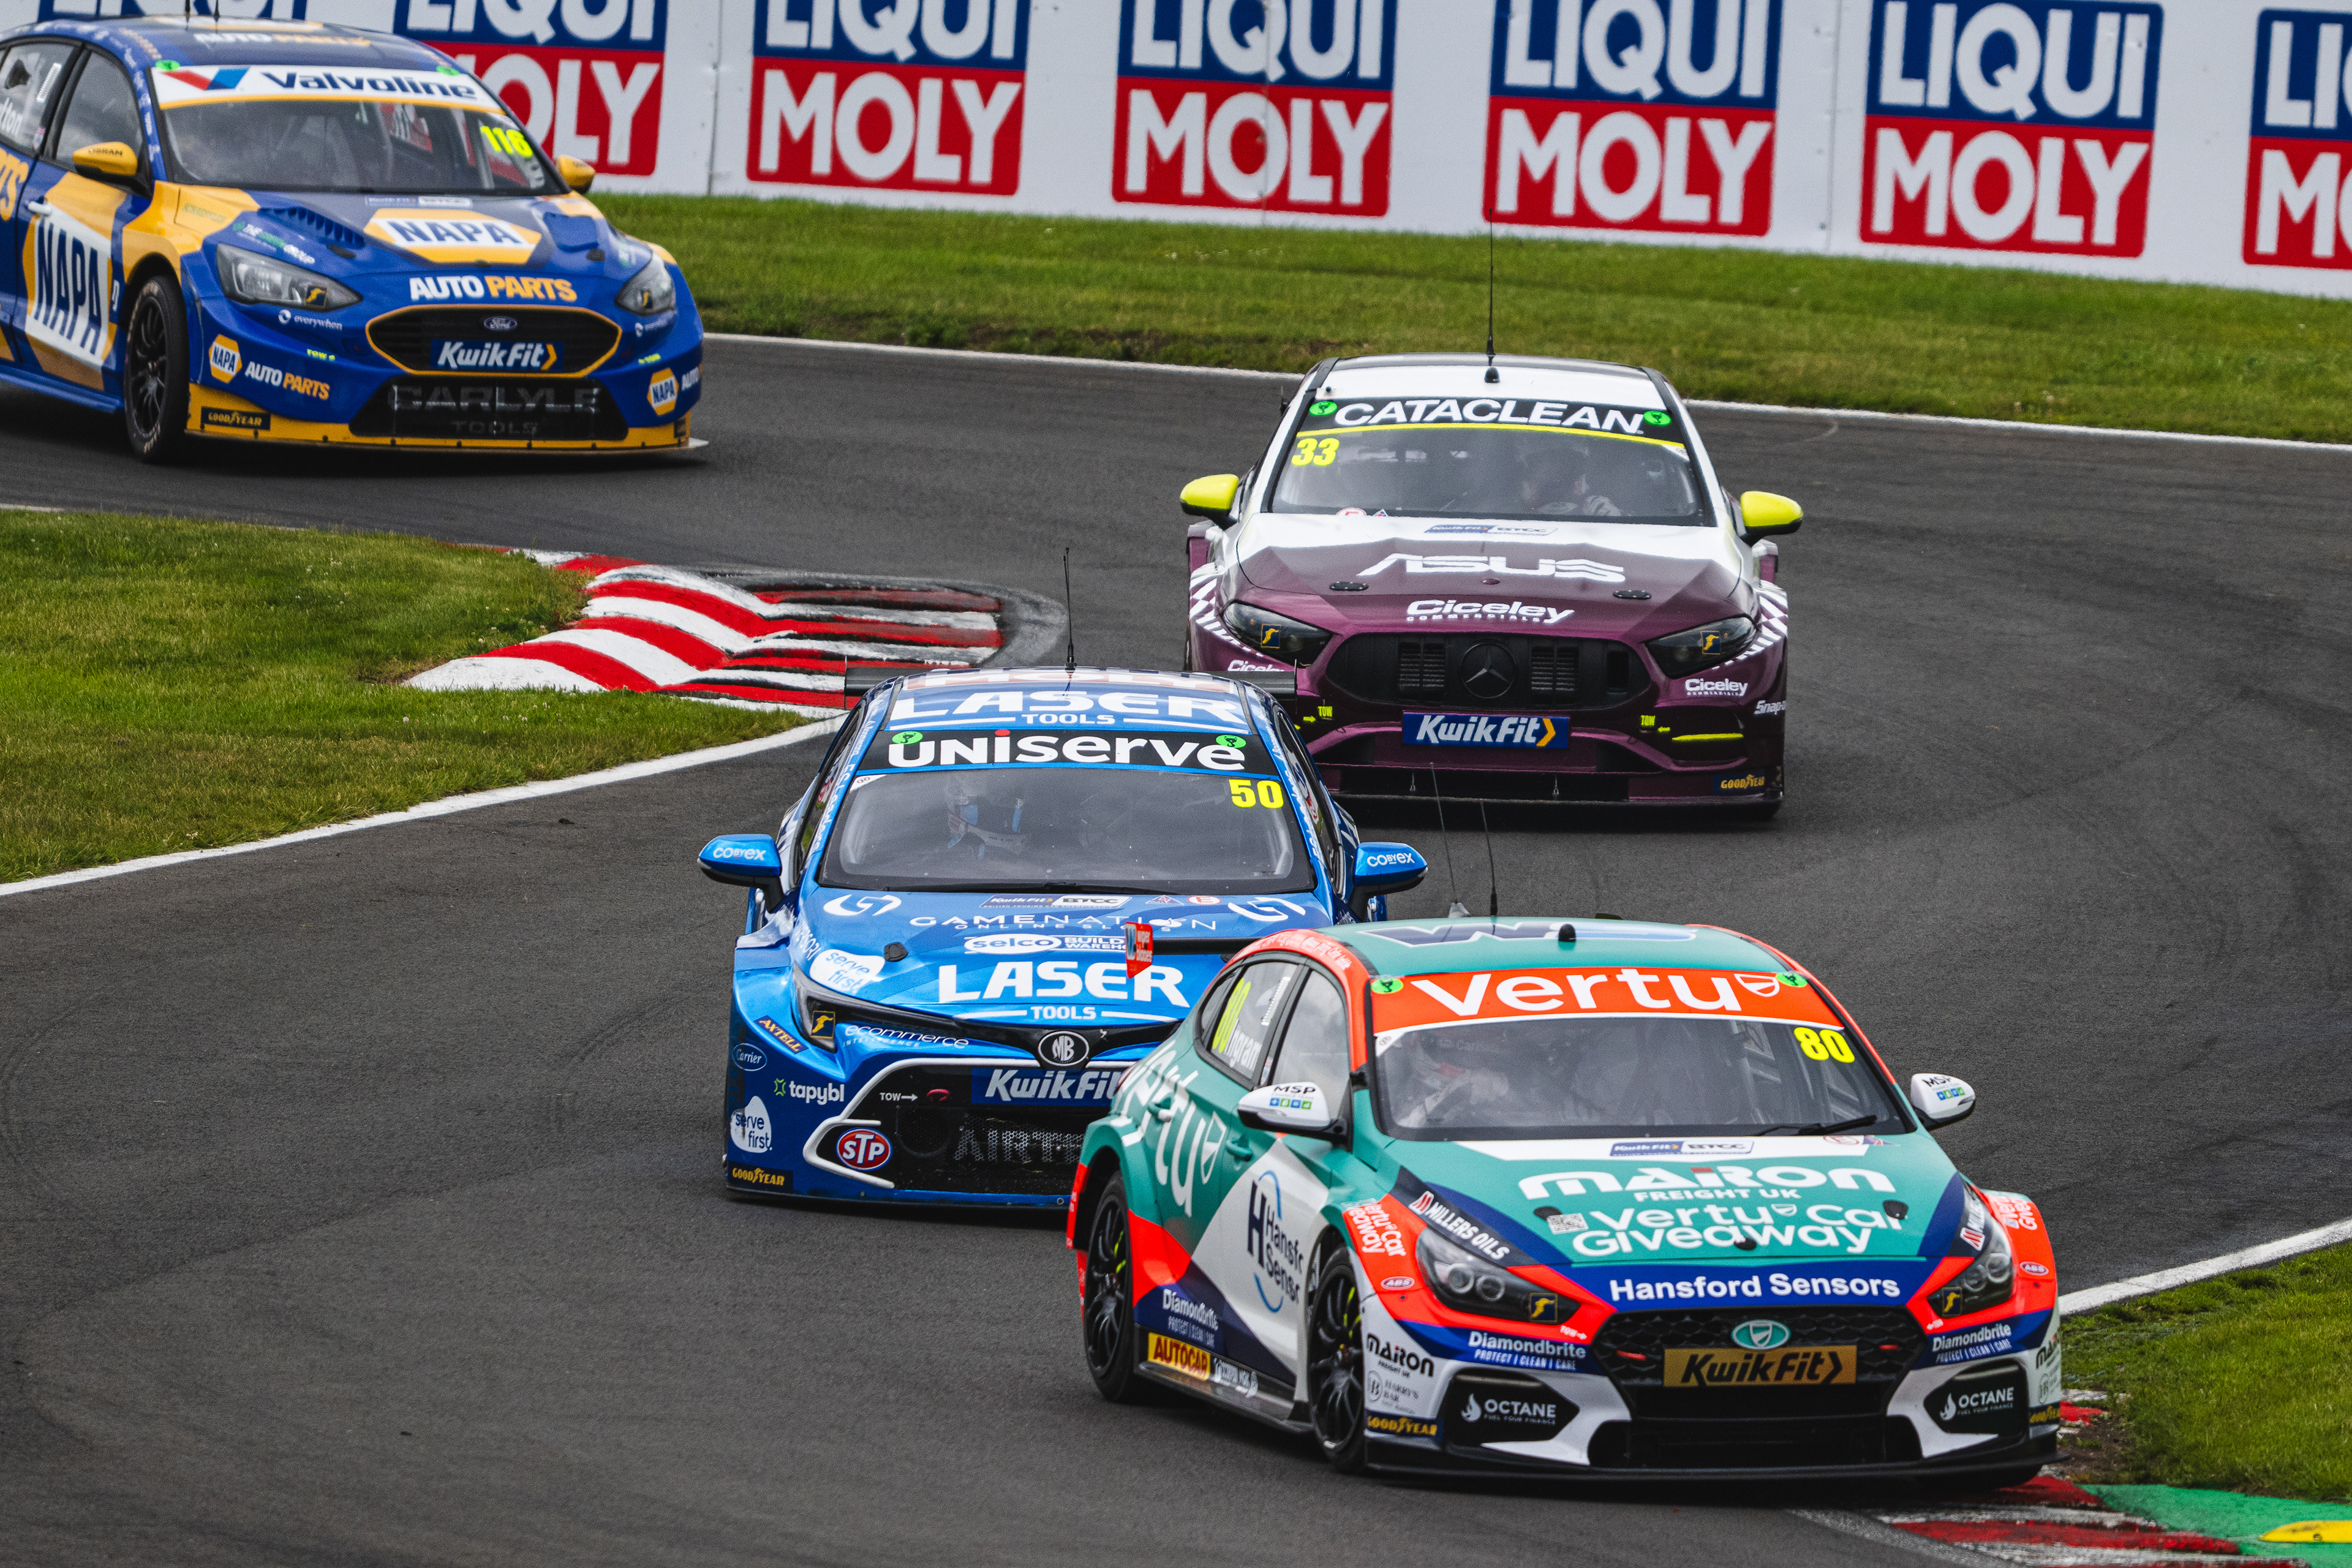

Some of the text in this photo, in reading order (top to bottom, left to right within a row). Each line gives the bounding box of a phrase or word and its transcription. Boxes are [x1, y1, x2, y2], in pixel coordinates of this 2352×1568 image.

[1132, 0, 1383, 81] LIQUI
[1504, 0, 1768, 100] LIQUI
[1879, 1, 2149, 120] LIQUI
[260, 71, 477, 100] Valvoline
[454, 54, 660, 166] OLY
[759, 69, 1022, 184] MOLY
[480, 126, 533, 157] 116
[1125, 89, 1389, 204] MOLY
[1496, 109, 1773, 225] MOLY
[1872, 127, 2148, 245] MOLY
[386, 220, 522, 244] NAPA
[35, 216, 104, 356] NAPA
[409, 276, 578, 302] AUTO PARTS
[293, 315, 343, 330] everywhen
[212, 345, 238, 375] NAPA
[245, 361, 330, 401] AUTO PARTS
[652, 379, 676, 404] NAPA
[387, 385, 601, 412] CARLYLE
[207, 410, 263, 428] GOODYEAR
[1334, 398, 1645, 435] CATACLEAN
[1291, 438, 1340, 466] 33
[1356, 553, 1626, 583] ASUS
[1406, 599, 1575, 624] Ciceley
[1406, 613, 1541, 622] COMMERCIALS
[1227, 659, 1286, 671] Cicel
[1685, 678, 1749, 696] Ciceley
[889, 690, 1249, 725] LASER
[1021, 714, 1116, 725] TOOLS
[1317, 705, 1333, 717] TOW
[1640, 715, 1656, 727] TOW
[1228, 778, 1284, 809] 50
[1082, 924, 1171, 932] SLS
[972, 937, 1050, 949] selco
[826, 952, 870, 974] serve
[938, 961, 1190, 1008] LASER
[1411, 968, 1743, 1017] Vertu
[1030, 1005, 1096, 1020] TOOLS
[758, 1019, 801, 1053] AXTELL
[845, 1024, 970, 1049] ecommerce
[1052, 1035, 1075, 1061] MB
[1793, 1027, 1855, 1064] 80
[736, 1047, 762, 1065] Carrier
[790, 1080, 845, 1106] tapybl
[880, 1091, 902, 1101] TOW
[1273, 1085, 1316, 1095] MSP
[735, 1114, 764, 1130] serve
[842, 1134, 886, 1164] STP
[731, 1167, 785, 1186] GOODYEAR
[1634, 1188, 1801, 1203] FREIGHT UK
[1424, 1201, 1510, 1260] MILLERS OILS
[1589, 1203, 1902, 1232] Vertu Car
[1380, 1230, 1407, 1257] Car
[1572, 1223, 1872, 1256] Giveaway
[2024, 1264, 2045, 1272] ABS
[1385, 1278, 1412, 1287] ABS
[1610, 1272, 1901, 1302] Hansford Sensors
[1162, 1288, 1219, 1332] Diamondbrite
[1468, 1330, 1587, 1359] Diamondbrite
[1559, 1325, 1578, 1338] TOW
[1931, 1322, 2013, 1352] Diamondbrite
[1153, 1336, 1208, 1374] AUTOCAR
[1474, 1348, 1577, 1371] PROTECT CLEAN CARE
[1936, 1338, 2013, 1364] PROTECT CLEAN CARE
[1483, 1398, 1557, 1419] OCTANE
[1958, 1386, 2015, 1409] OCTANE
[1366, 1415, 1438, 1436] GOODYEAR
[1525, 1417, 1556, 1426] FINANCE
